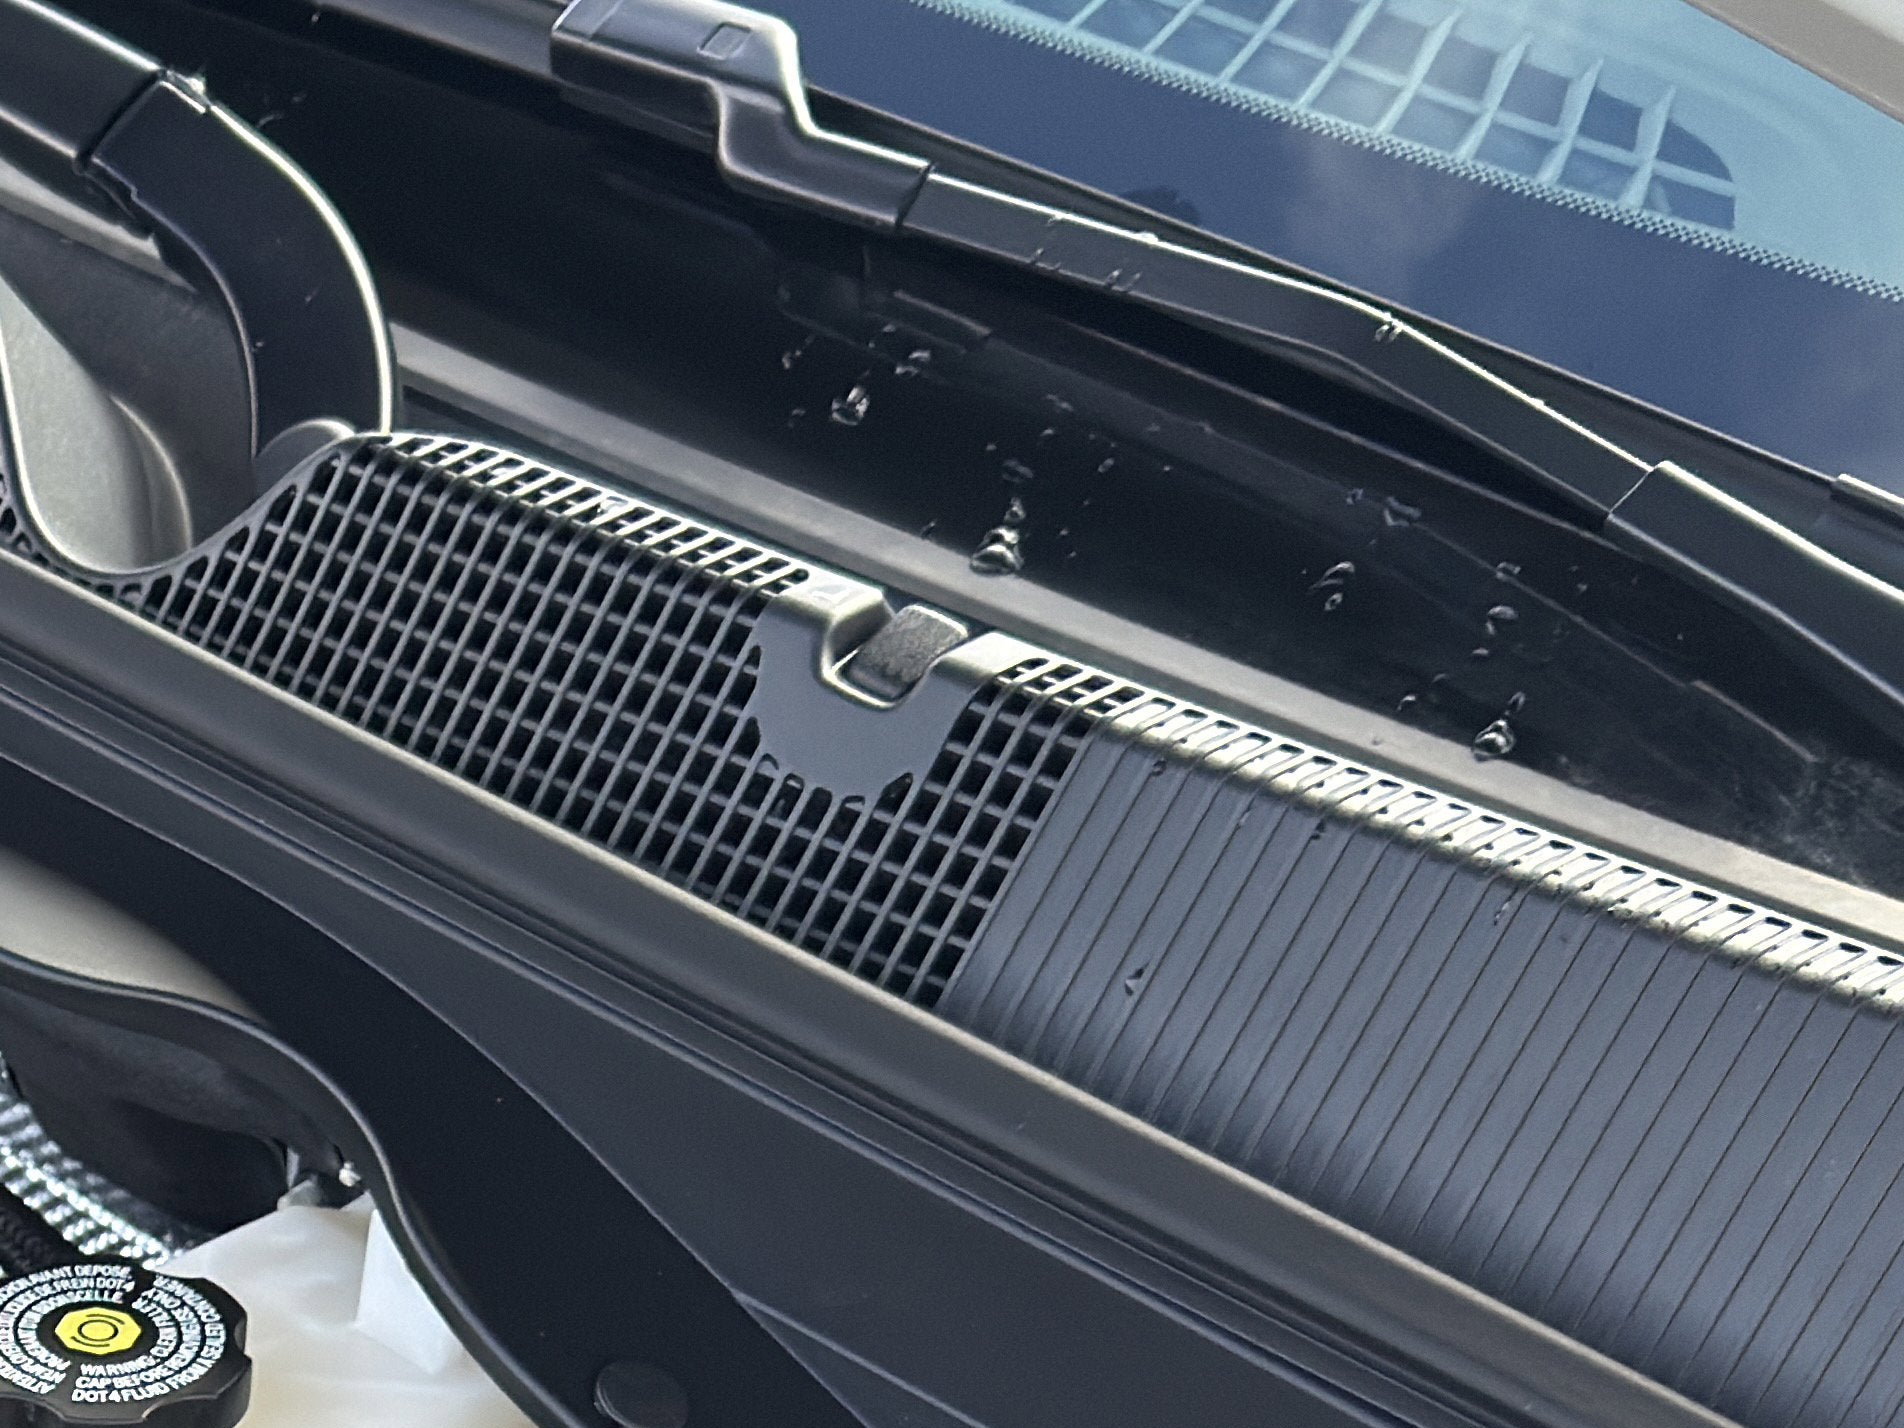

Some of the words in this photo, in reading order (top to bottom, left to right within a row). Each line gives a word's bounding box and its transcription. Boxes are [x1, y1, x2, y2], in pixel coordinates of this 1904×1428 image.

[142, 1288, 181, 1309] ONLY
[132, 1297, 176, 1327] FILLER
[201, 1323, 226, 1359] SEALED
[197, 1356, 216, 1368] A
[75, 1376, 111, 1388] CAP
[113, 1365, 175, 1389] BEFORE
[166, 1362, 209, 1389] FROM
[72, 1388, 108, 1402] DOT
[109, 1390, 121, 1402] 4
[121, 1382, 170, 1402] FLUID
